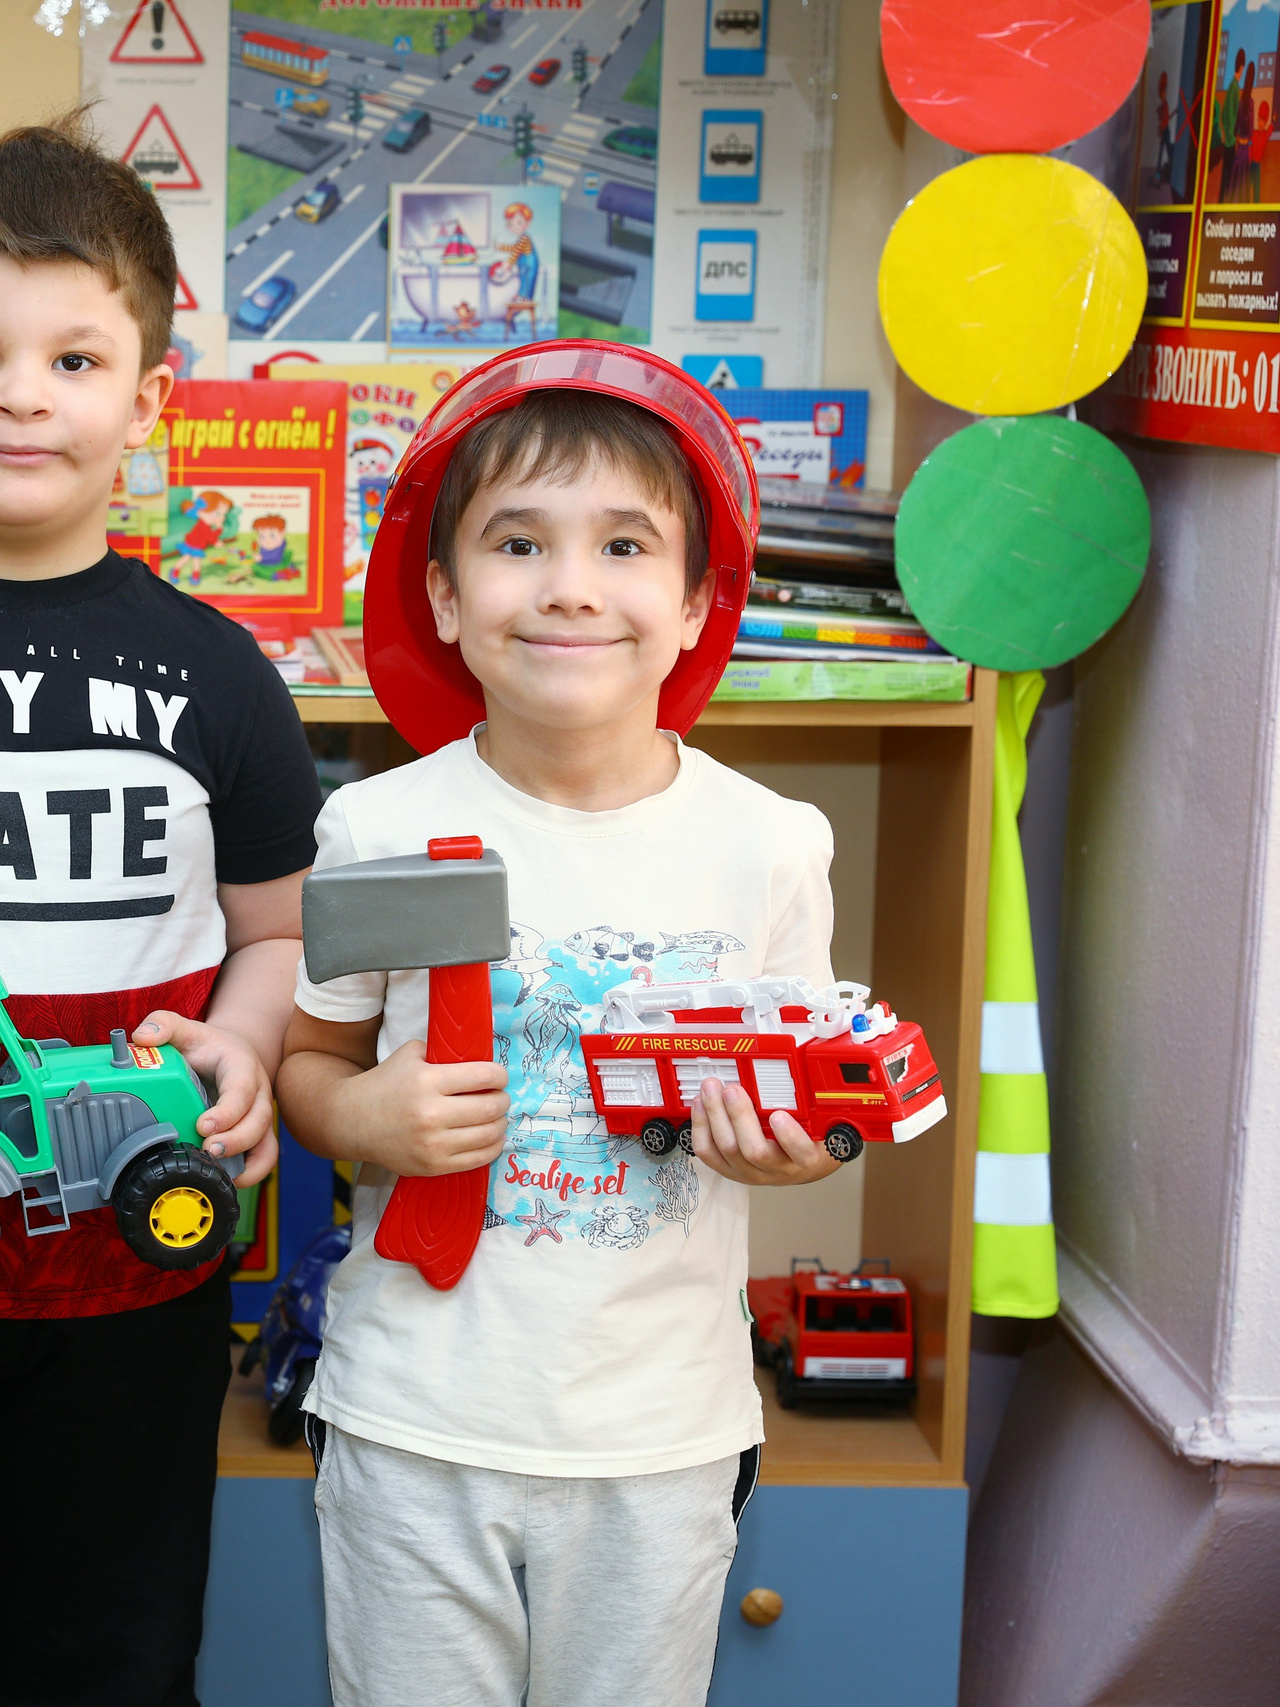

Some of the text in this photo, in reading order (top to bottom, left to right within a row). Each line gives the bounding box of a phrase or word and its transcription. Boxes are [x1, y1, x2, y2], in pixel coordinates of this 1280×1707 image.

[1242, 223, 1277, 242] пожаре
[704, 260, 749, 280] ДПС
[1216, 269, 1250, 289] попроси
[1251, 270, 1264, 286] их
[1227, 291, 1279, 314] пожарных!
[1152, 344, 1249, 411] ЗВОНИТЬ:
[351, 384, 417, 410] ОКИ
[171, 407, 236, 460] играй
[238, 418, 252, 450] с
[26, 644, 81, 661] ALL
[115, 655, 189, 682] TIME
[88, 677, 189, 755] MY
[642, 1038, 728, 1051] FIRE RESCUE
[505, 1154, 631, 1201] Sealife set
